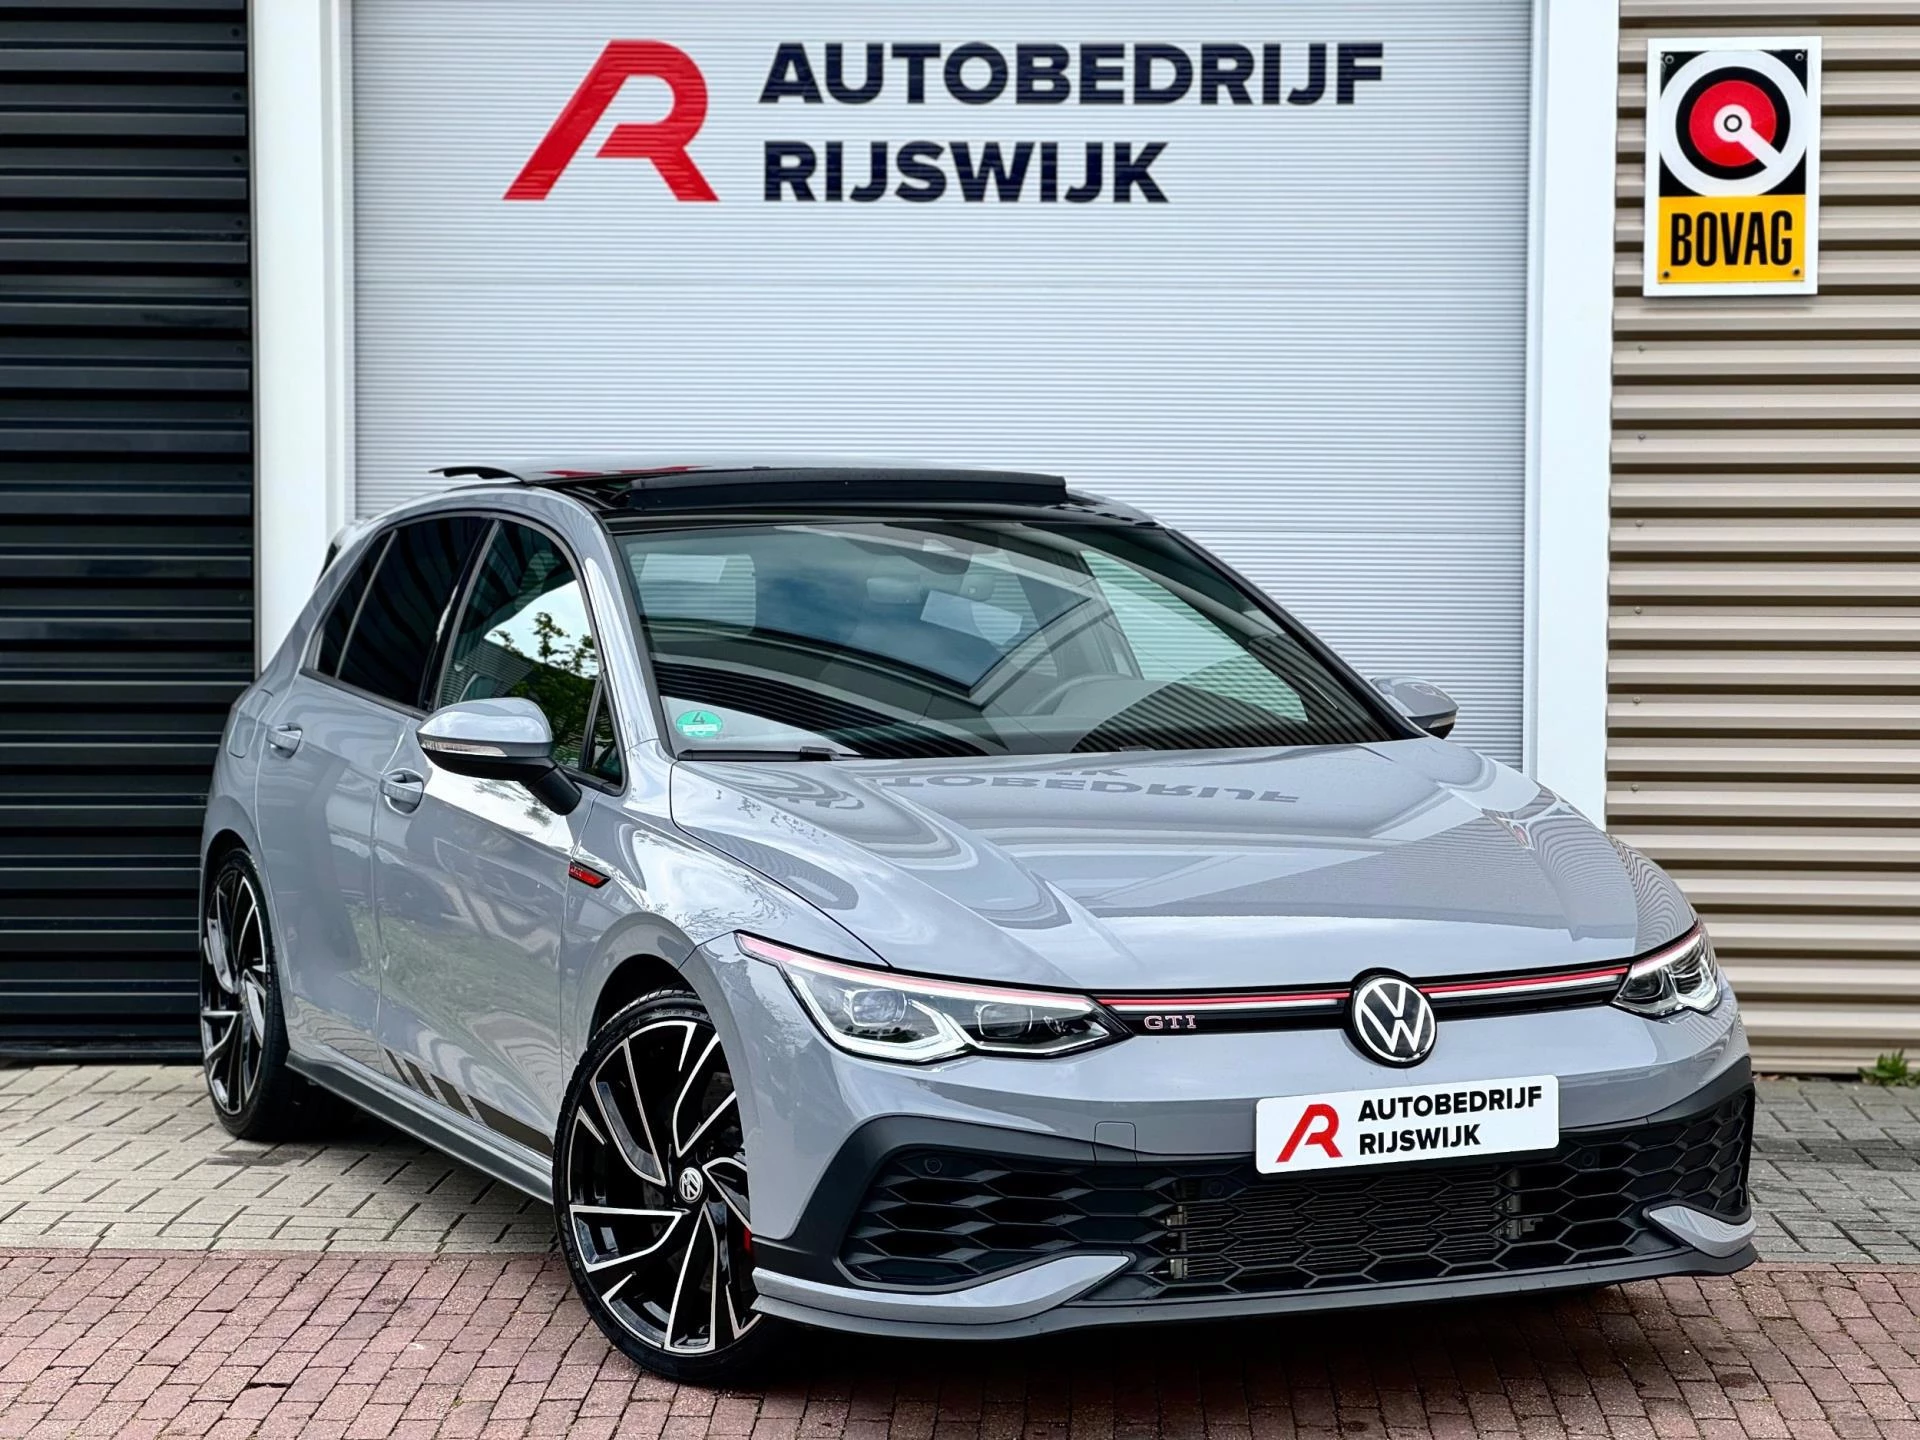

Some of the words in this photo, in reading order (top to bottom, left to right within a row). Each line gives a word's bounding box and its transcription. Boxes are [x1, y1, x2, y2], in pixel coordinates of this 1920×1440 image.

[759, 42, 1383, 105] AUTOBEDRIJF
[764, 140, 1169, 203] RIJSWIJK
[1670, 210, 1793, 267] BOVAG
[1143, 1014, 1197, 1030] GTI
[1358, 1085, 1542, 1122] AUTOBEDRIJF
[1359, 1123, 1481, 1156] RIJSWIJK
